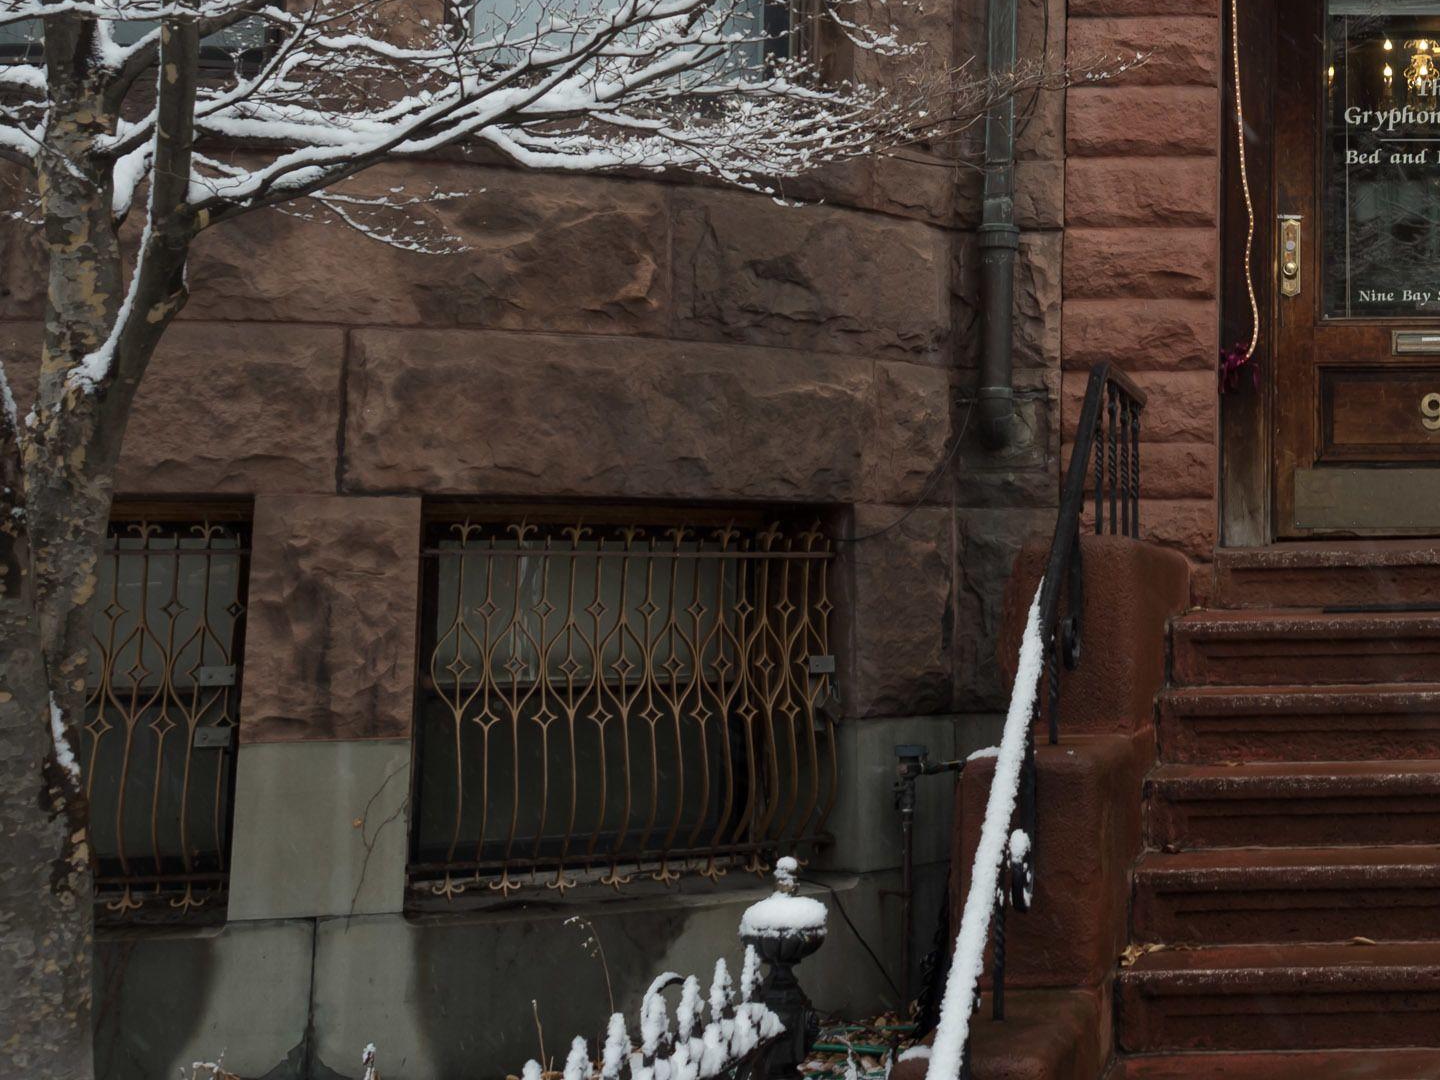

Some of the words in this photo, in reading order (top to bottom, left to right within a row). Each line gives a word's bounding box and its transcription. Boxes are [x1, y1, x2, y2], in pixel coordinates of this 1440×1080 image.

[1345, 148, 1382, 165] Bed
[1390, 148, 1429, 165] and
[1358, 289, 1395, 302] Nine
[1402, 289, 1431, 305] Bay
